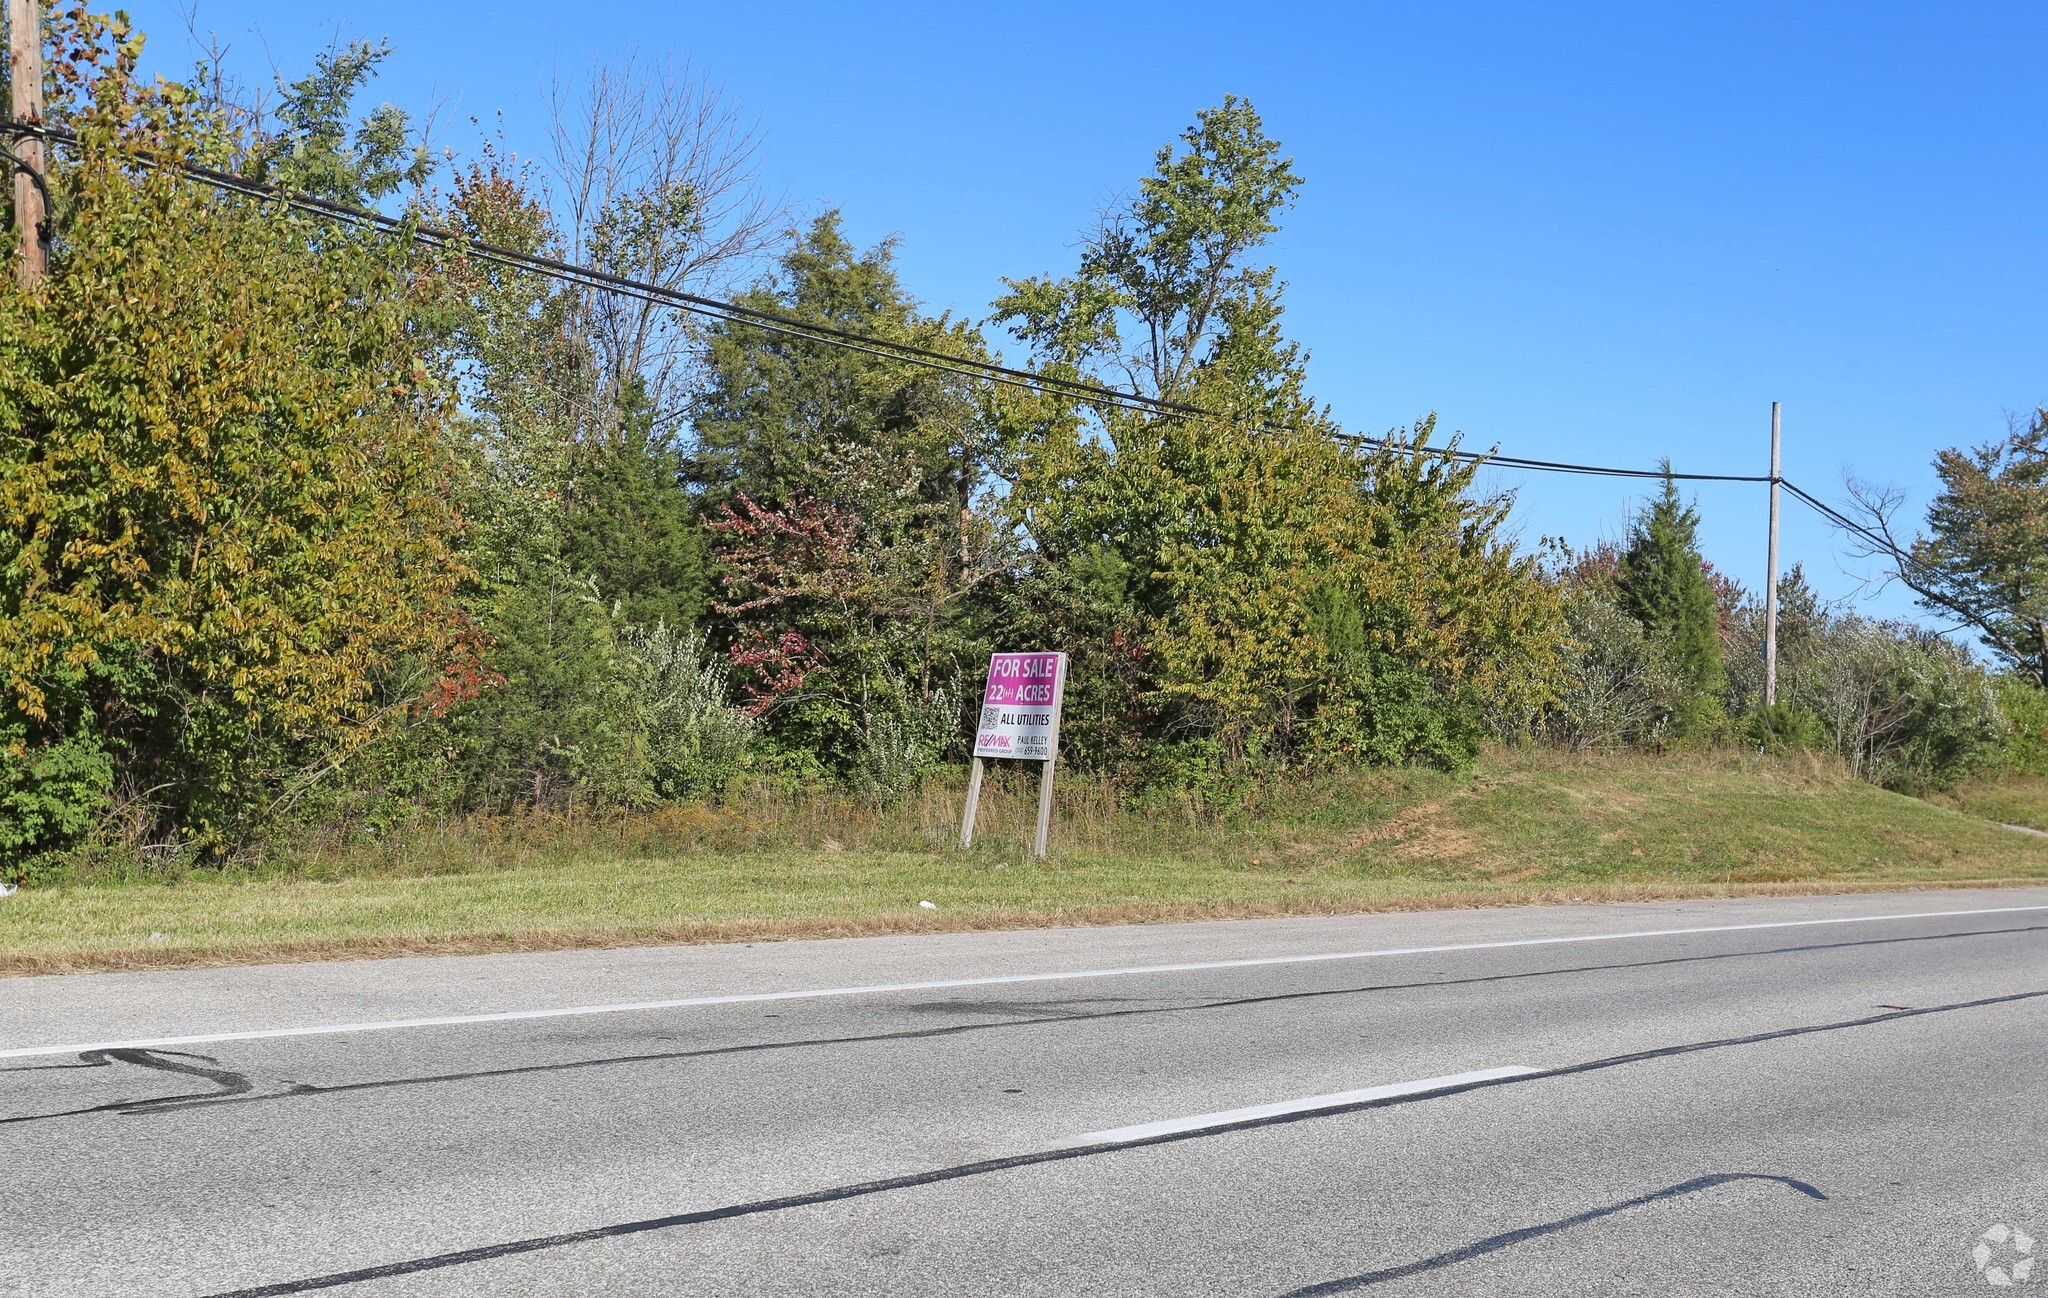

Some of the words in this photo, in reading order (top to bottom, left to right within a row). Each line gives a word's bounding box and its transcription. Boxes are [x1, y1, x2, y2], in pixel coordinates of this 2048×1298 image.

[993, 659, 1020, 678] FOR
[1022, 658, 1054, 678] SALE
[1015, 684, 1051, 702] ACRES
[1000, 713, 1015, 725] ALL
[1017, 714, 1050, 726] UTILITIES
[978, 734, 1012, 748] RE/MAX
[1017, 735, 1030, 745] PAUL
[1030, 735, 1048, 745] KELLEY
